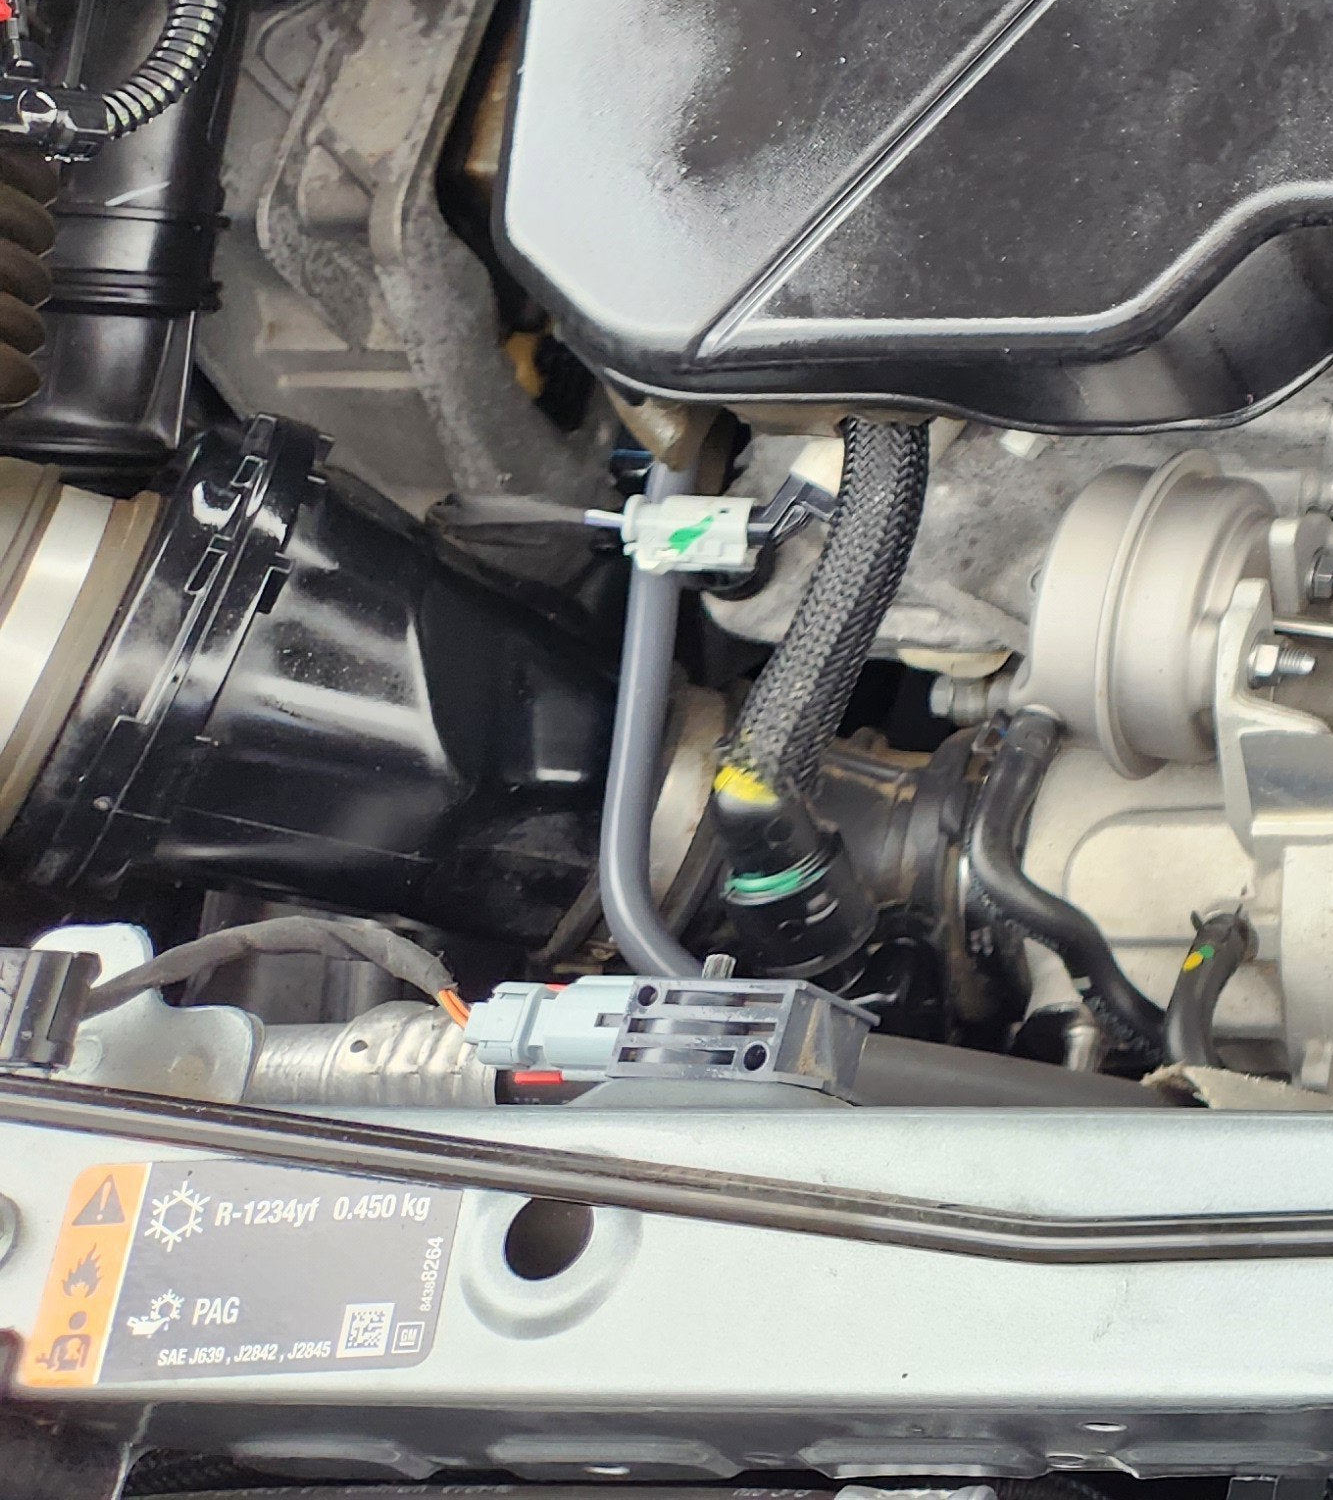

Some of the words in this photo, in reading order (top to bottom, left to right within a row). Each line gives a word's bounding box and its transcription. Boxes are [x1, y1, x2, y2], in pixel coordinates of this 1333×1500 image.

[214, 1195, 321, 1228] R-1234yf
[332, 1192, 398, 1221] 0.450
[400, 1192, 432, 1222] kg
[191, 1296, 241, 1327] PAG
[399, 1328, 419, 1342] GM
[156, 1347, 188, 1367] SAE
[286, 1340, 332, 1361] J2845
